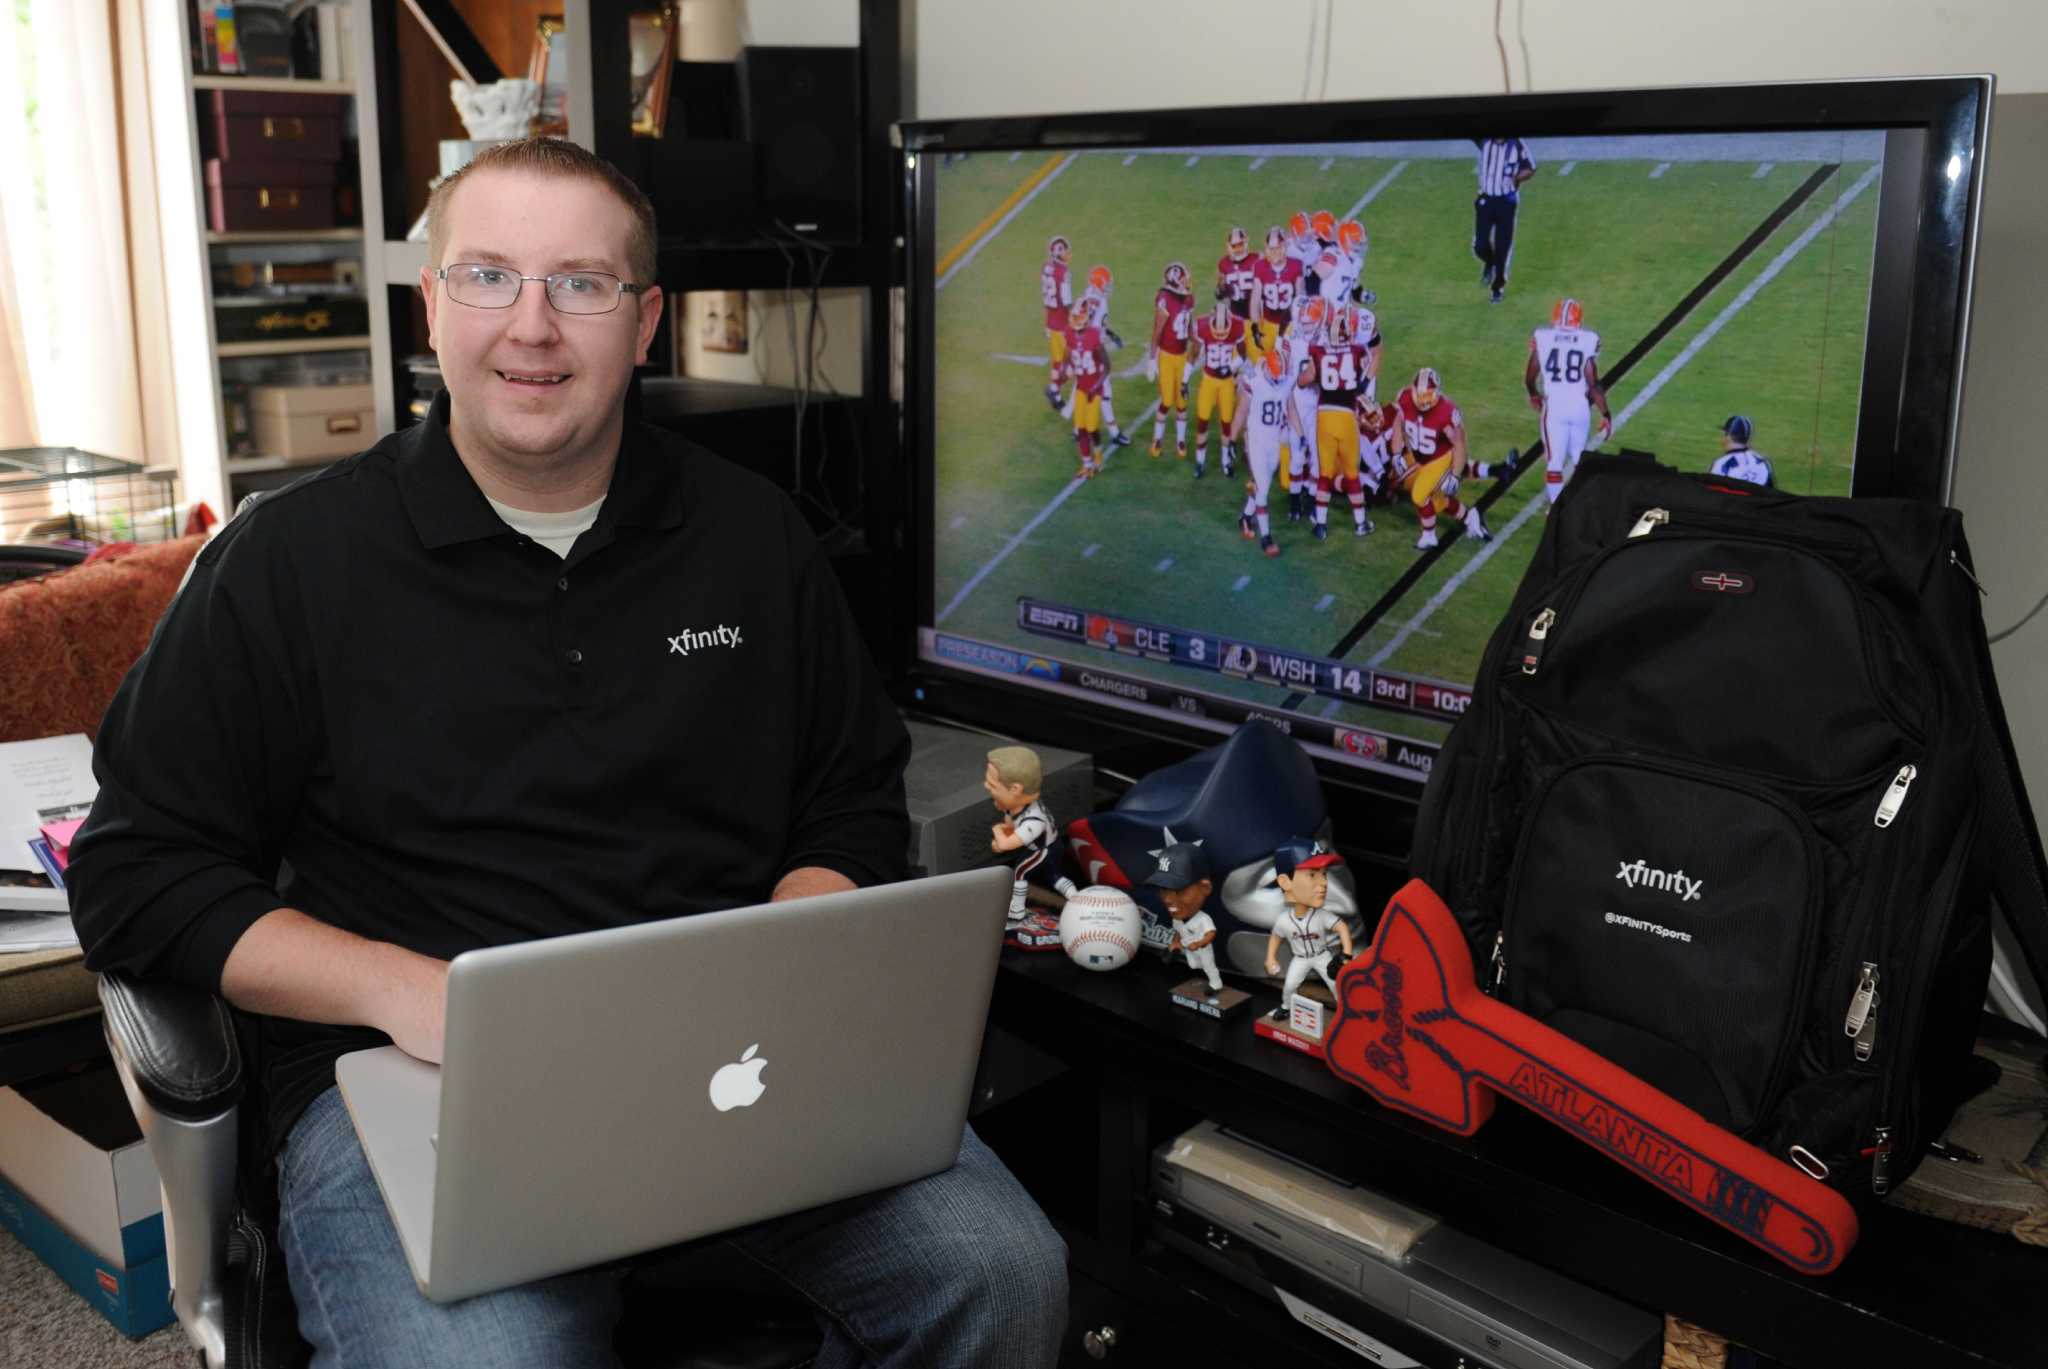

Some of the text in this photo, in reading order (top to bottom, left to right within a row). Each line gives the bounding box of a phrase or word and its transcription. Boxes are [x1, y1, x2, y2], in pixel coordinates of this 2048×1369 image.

[1263, 282, 1295, 311] 93
[1320, 355, 1358, 391] 64
[1545, 348, 1584, 383] 48
[1261, 401, 1282, 426] 81
[667, 624, 740, 656] xfinity
[1029, 606, 1079, 631] ESPN
[1135, 627, 1170, 653] CLE
[1189, 638, 1206, 661] 3
[1269, 654, 1317, 685] WSH
[1331, 666, 1362, 694] 14
[1375, 678, 1406, 701] 3rd
[1080, 673, 1148, 701] CHARGERS
[1397, 747, 1433, 772] Aug
[1615, 859, 1703, 901] xfinity
[1604, 911, 1692, 942] @XFINITYSports
[1508, 1062, 1694, 1194] ATLANTA
